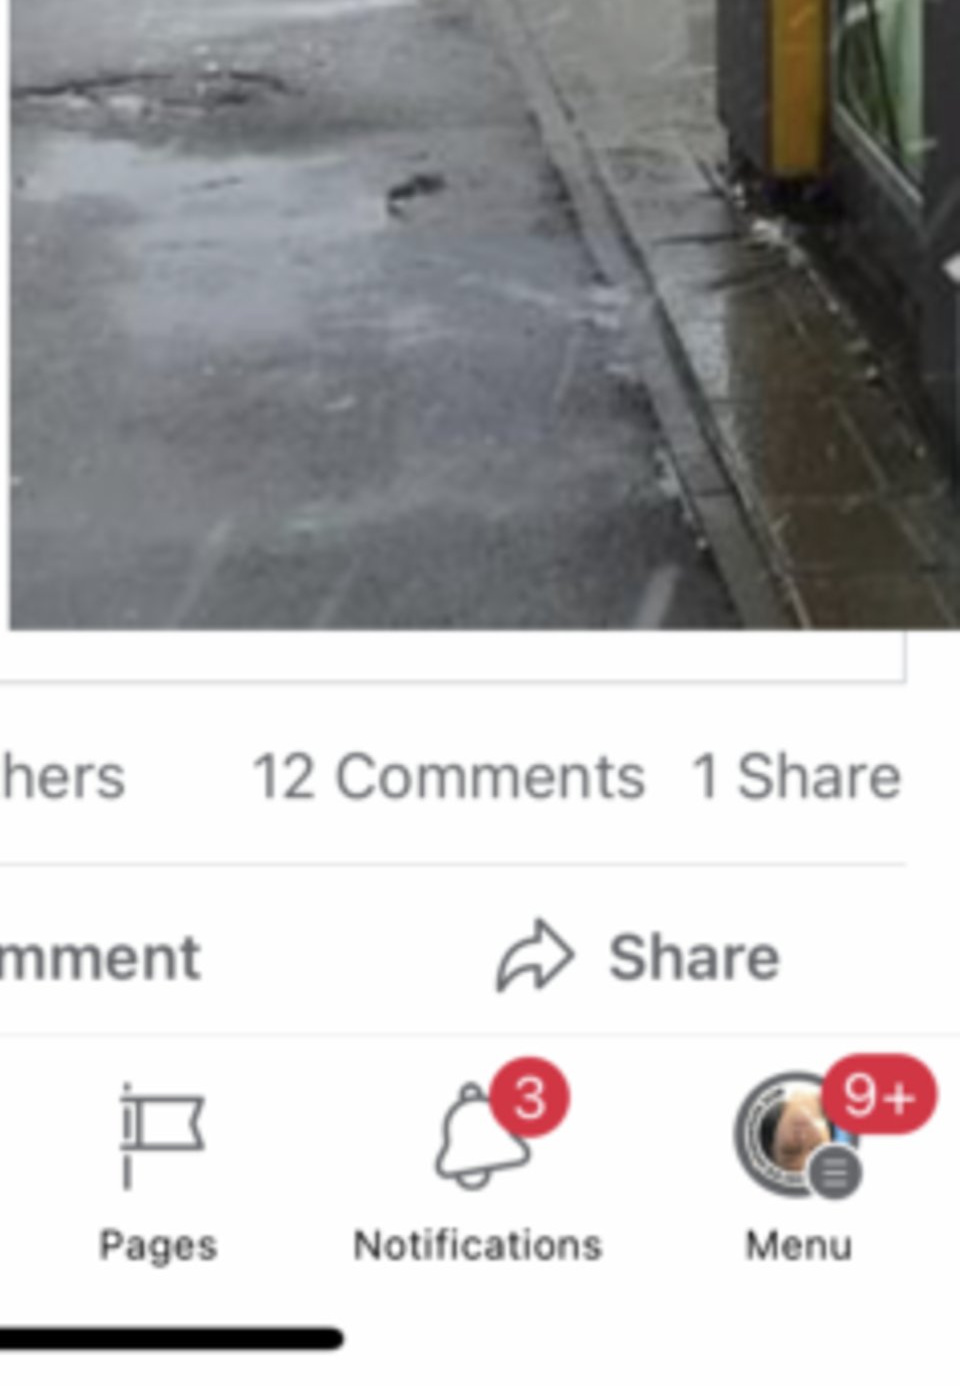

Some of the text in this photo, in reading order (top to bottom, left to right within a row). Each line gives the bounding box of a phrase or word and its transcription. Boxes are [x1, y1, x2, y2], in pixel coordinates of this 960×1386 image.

[254, 751, 646, 801] 12 Comments
[694, 751, 901, 801] 1 Share
[609, 930, 780, 982] Share
[515, 1074, 547, 1120] 3
[844, 1071, 916, 1119] 9+
[100, 1228, 217, 1268] Pages
[354, 1227, 602, 1261] Notifications
[746, 1229, 851, 1261] Menu
